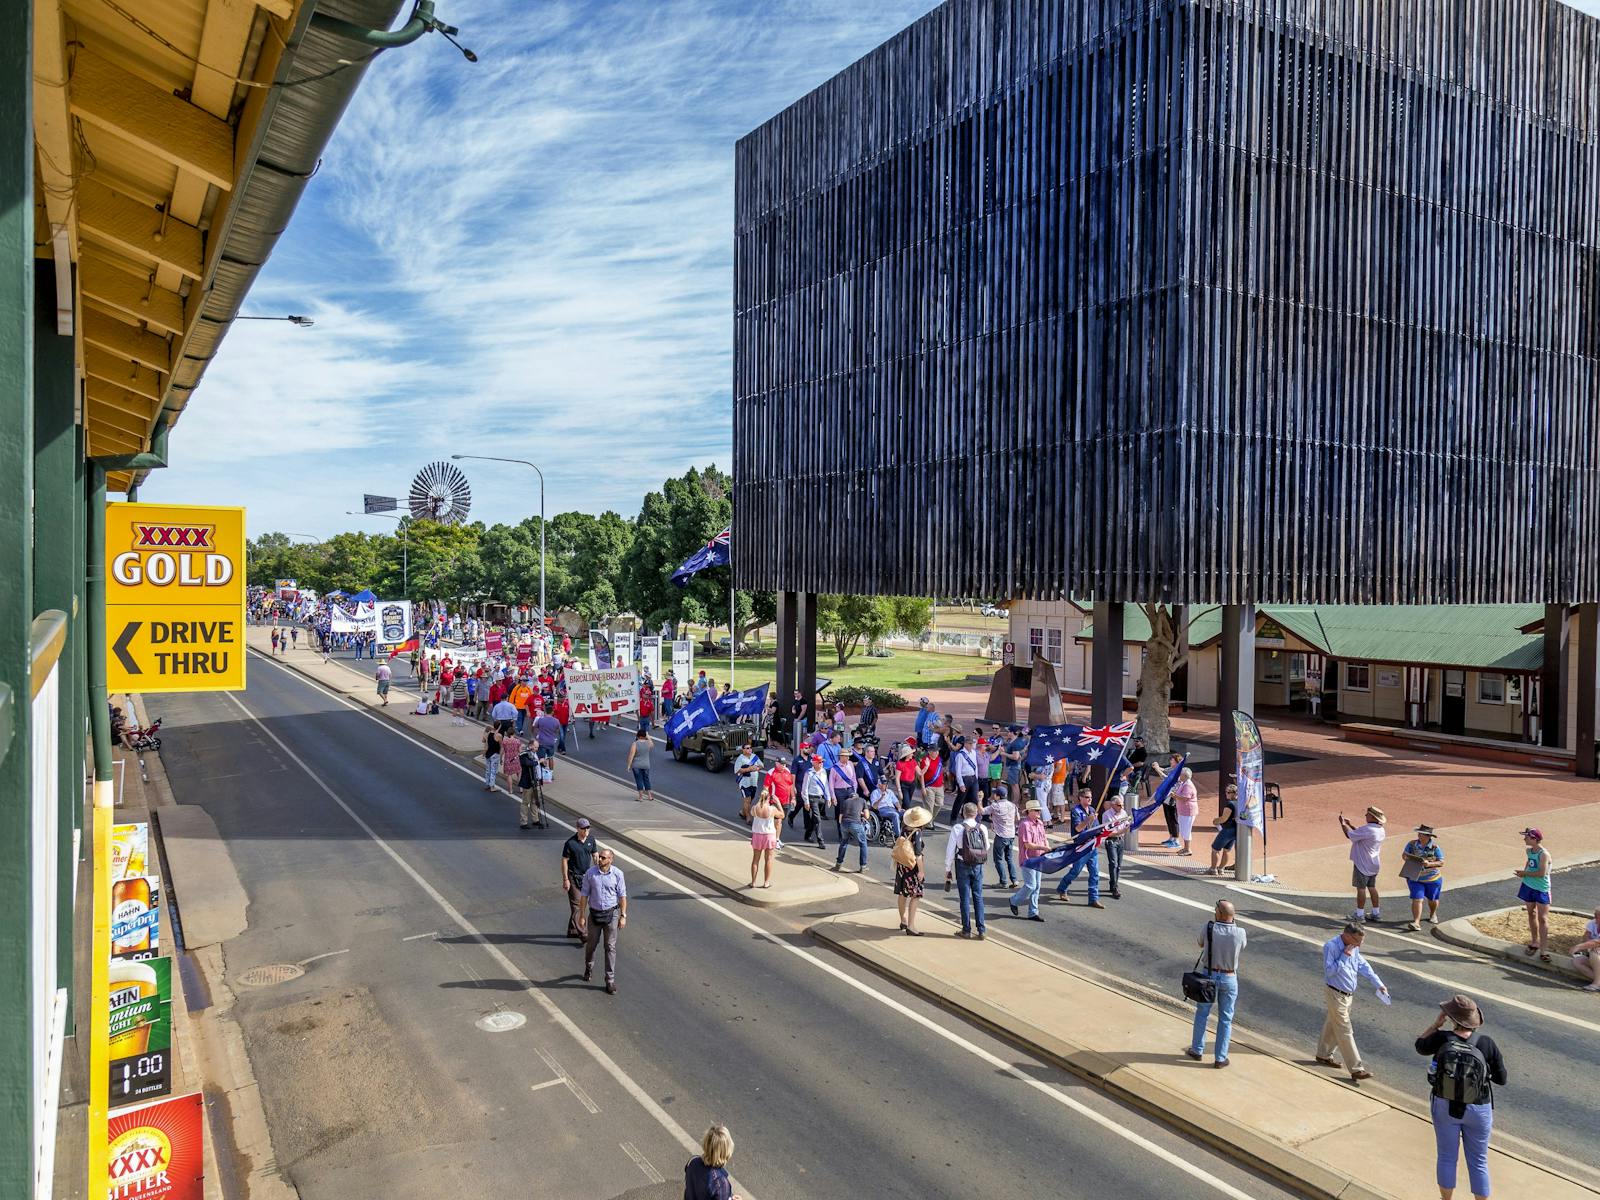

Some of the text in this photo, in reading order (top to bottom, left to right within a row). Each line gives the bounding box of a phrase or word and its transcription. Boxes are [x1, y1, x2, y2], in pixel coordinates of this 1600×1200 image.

[138, 526, 209, 547] XXXX
[112, 552, 233, 586] GOLD
[150, 621, 234, 644] DRIVE
[154, 652, 228, 675] THRU
[605, 672, 631, 681] BRANCH
[574, 699, 629, 714] ALP
[118, 905, 141, 919] HAHN
[109, 988, 138, 1008] AHN
[109, 1001, 153, 1024] mium
[109, 1018, 132, 1033] IGHT
[142, 1084, 163, 1093] BOTTLES
